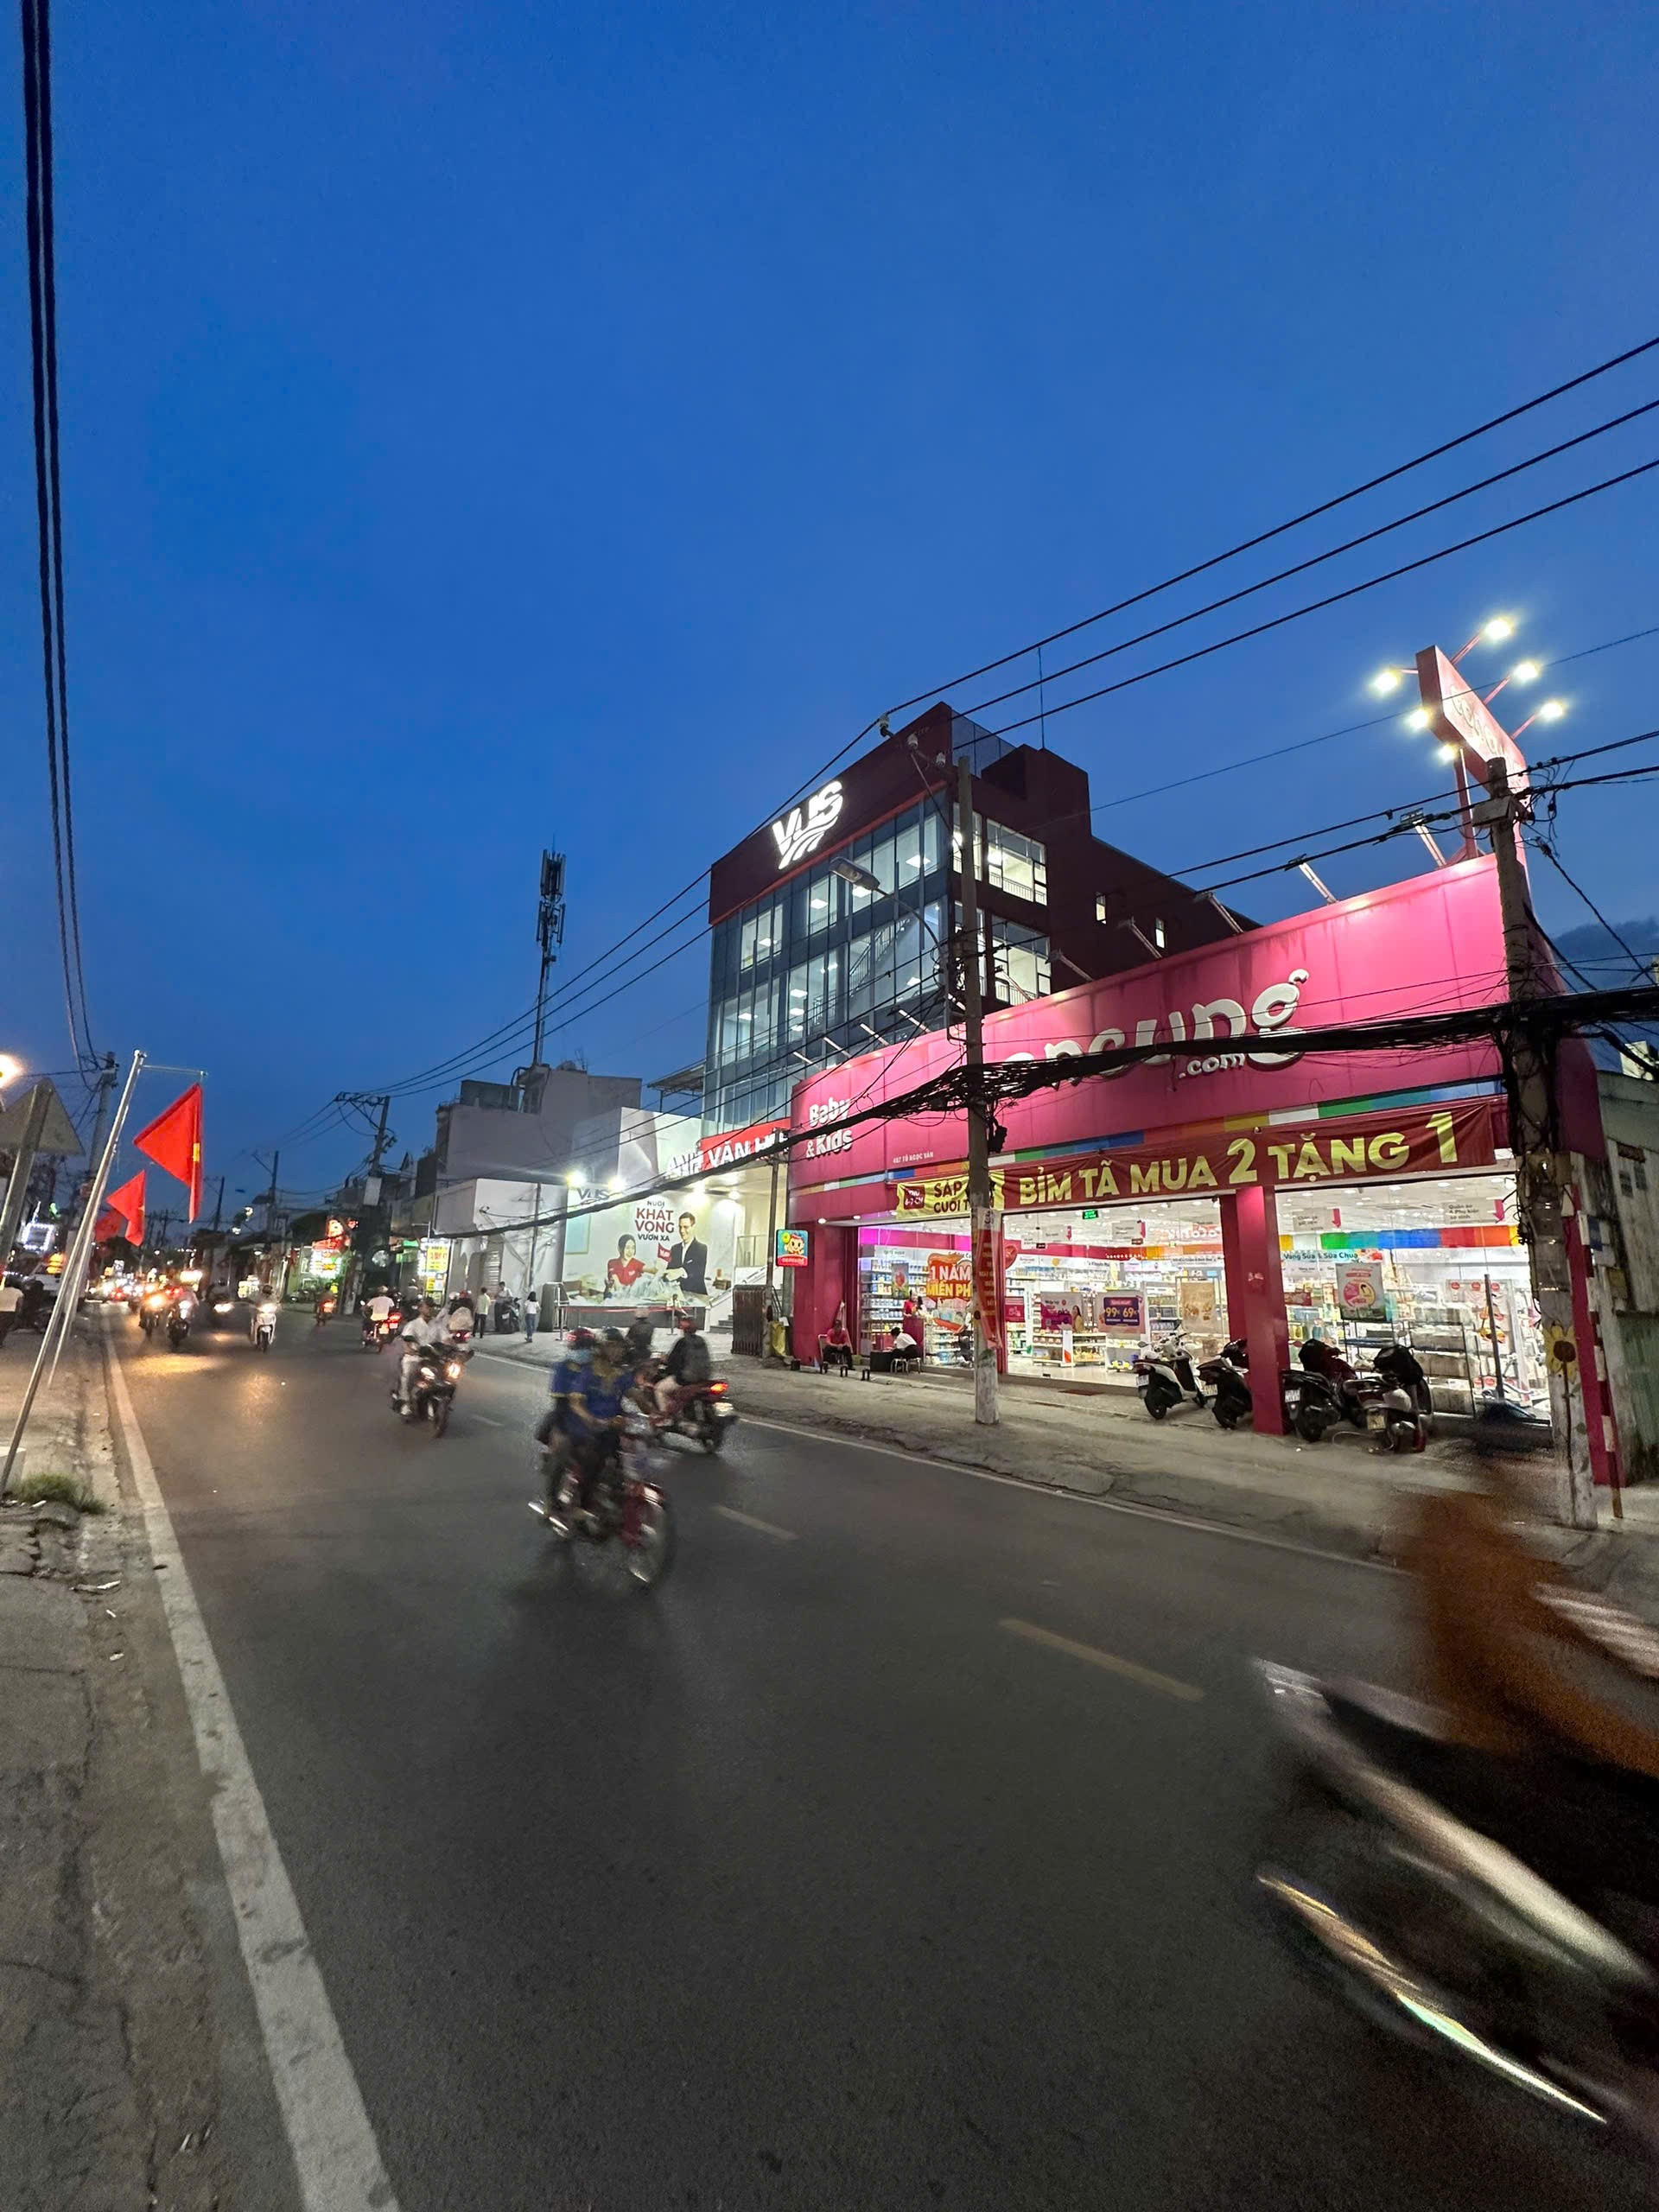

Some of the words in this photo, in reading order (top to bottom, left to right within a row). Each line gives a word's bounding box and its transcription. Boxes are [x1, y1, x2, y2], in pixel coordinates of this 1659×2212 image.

[772, 781, 843, 856] VUS
[1179, 1053, 1245, 1079] .com
[809, 1097, 850, 1127] Baby
[806, 1140, 816, 1158] &
[816, 1129, 853, 1153] Kids
[1020, 1167, 1071, 1205] BỈM
[1079, 1160, 1120, 1198] TÃ
[1130, 1156, 1218, 1193] MUA
[1227, 1138, 1257, 1184] 2
[1268, 1132, 1409, 1182] TẶNG
[1426, 1111, 1458, 1163] 1
[635, 1220, 675, 1233] VỌNG
[931, 1265, 937, 1281] 1
[955, 1281, 972, 1298] PH
